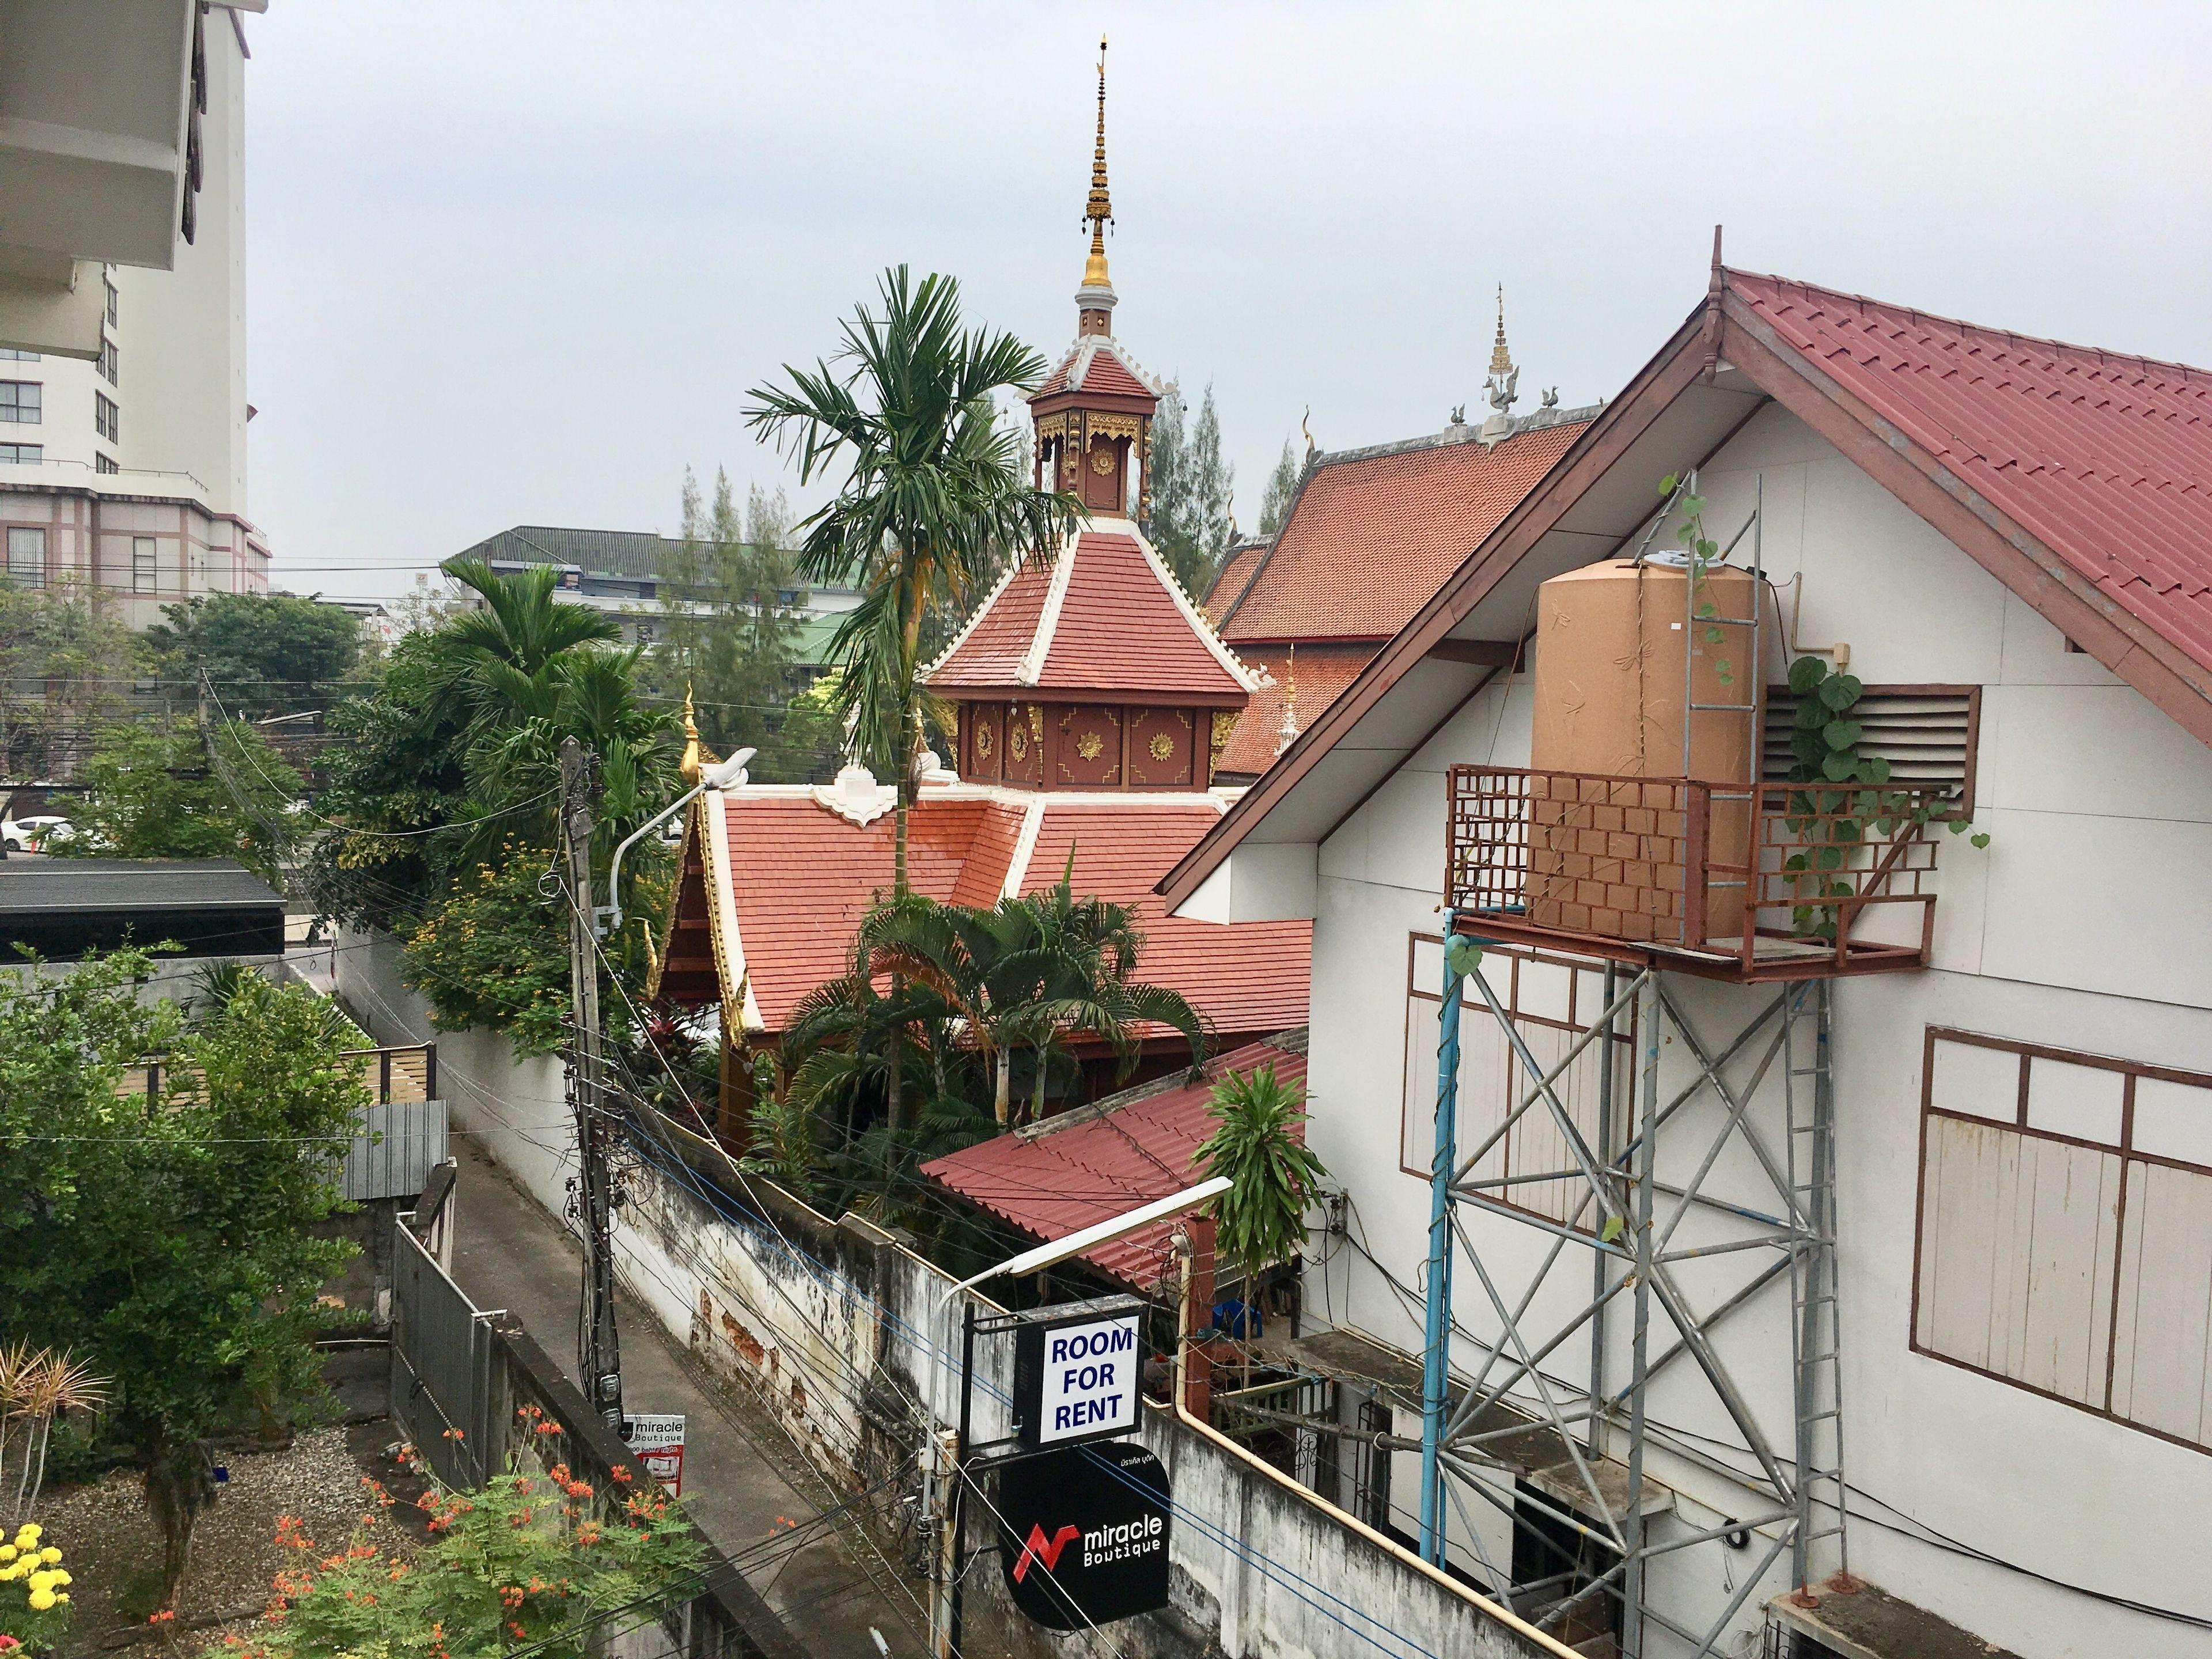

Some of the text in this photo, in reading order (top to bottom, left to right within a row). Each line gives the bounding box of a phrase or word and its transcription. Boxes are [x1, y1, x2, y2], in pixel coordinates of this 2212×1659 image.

[1052, 1328, 1132, 1363] ROOM
[1063, 1363, 1115, 1393] FOR
[635, 1422, 683, 1432] miracle
[1055, 1394, 1122, 1430] RENT
[1084, 1514, 1162, 1551] miracle
[1084, 1539, 1160, 1567] Boutique
